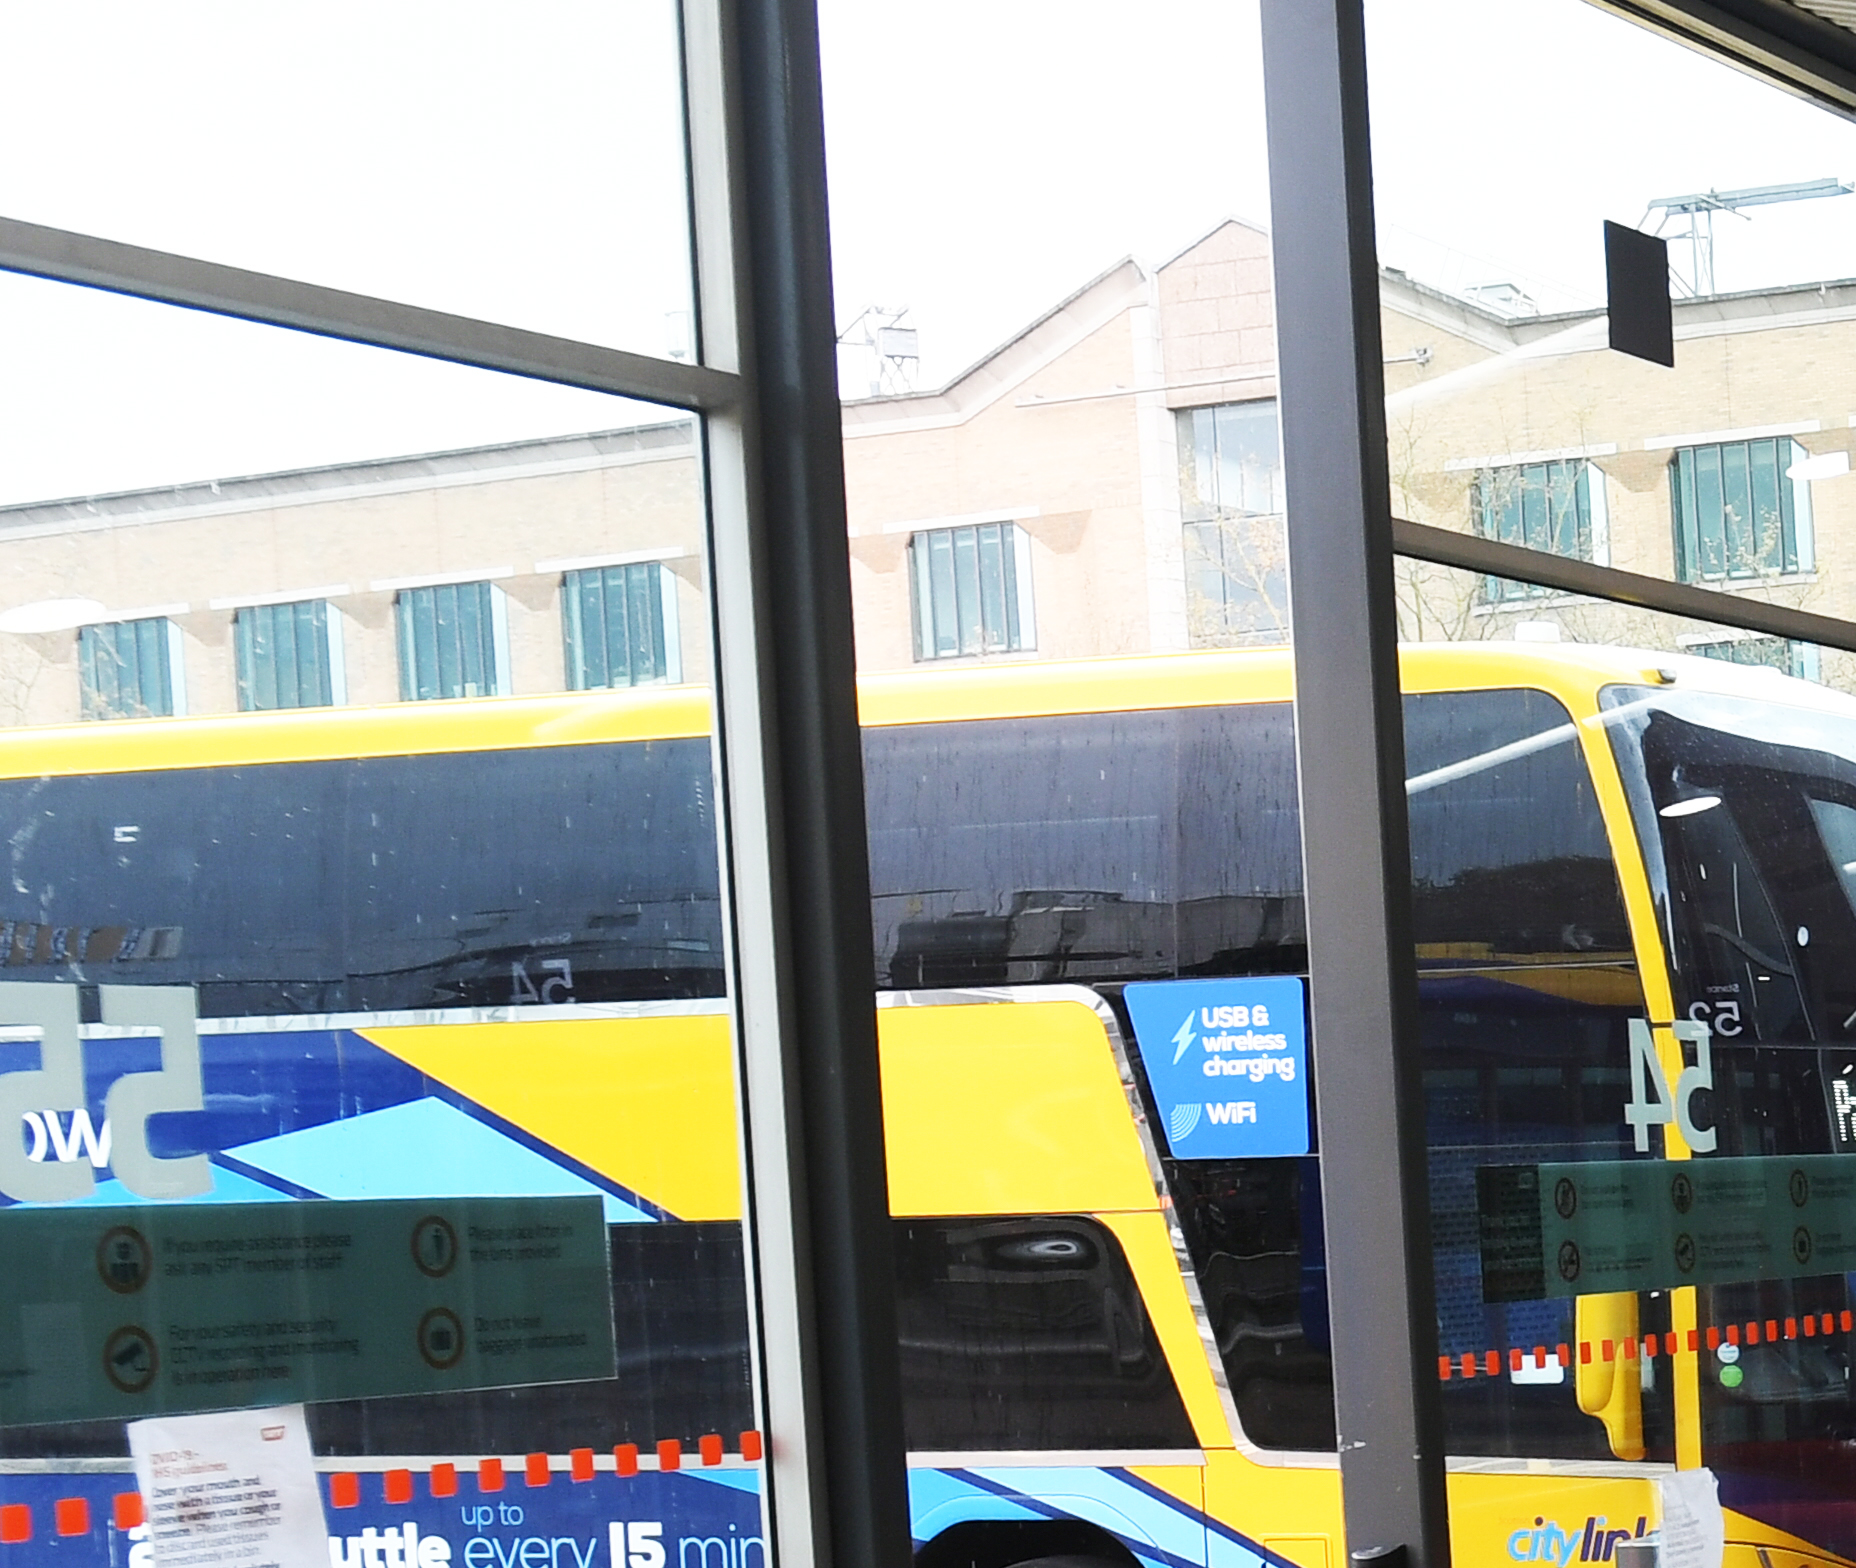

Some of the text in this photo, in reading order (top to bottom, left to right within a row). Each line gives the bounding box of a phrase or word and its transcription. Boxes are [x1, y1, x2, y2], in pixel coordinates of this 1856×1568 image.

[1202, 1004, 1270, 1028] USB &
[1202, 1030, 1288, 1053] wireless
[1203, 1053, 1296, 1083] charging
[1205, 1101, 1257, 1125] WiFi
[181, 1483, 204, 1497] your
[205, 1478, 241, 1492] mouth
[242, 1474, 261, 1487] and
[211, 1492, 244, 1505] tissue
[254, 1488, 277, 1501] your
[187, 1510, 217, 1523] when
[217, 1507, 238, 1520] you
[239, 1503, 270, 1518] cough
[461, 1503, 524, 1532] up to
[195, 1522, 229, 1535] Please
[230, 1516, 282, 1531] remember
[165, 1539, 206, 1553] discard
[208, 1536, 233, 1549] used
[233, 1531, 269, 1545] tissues
